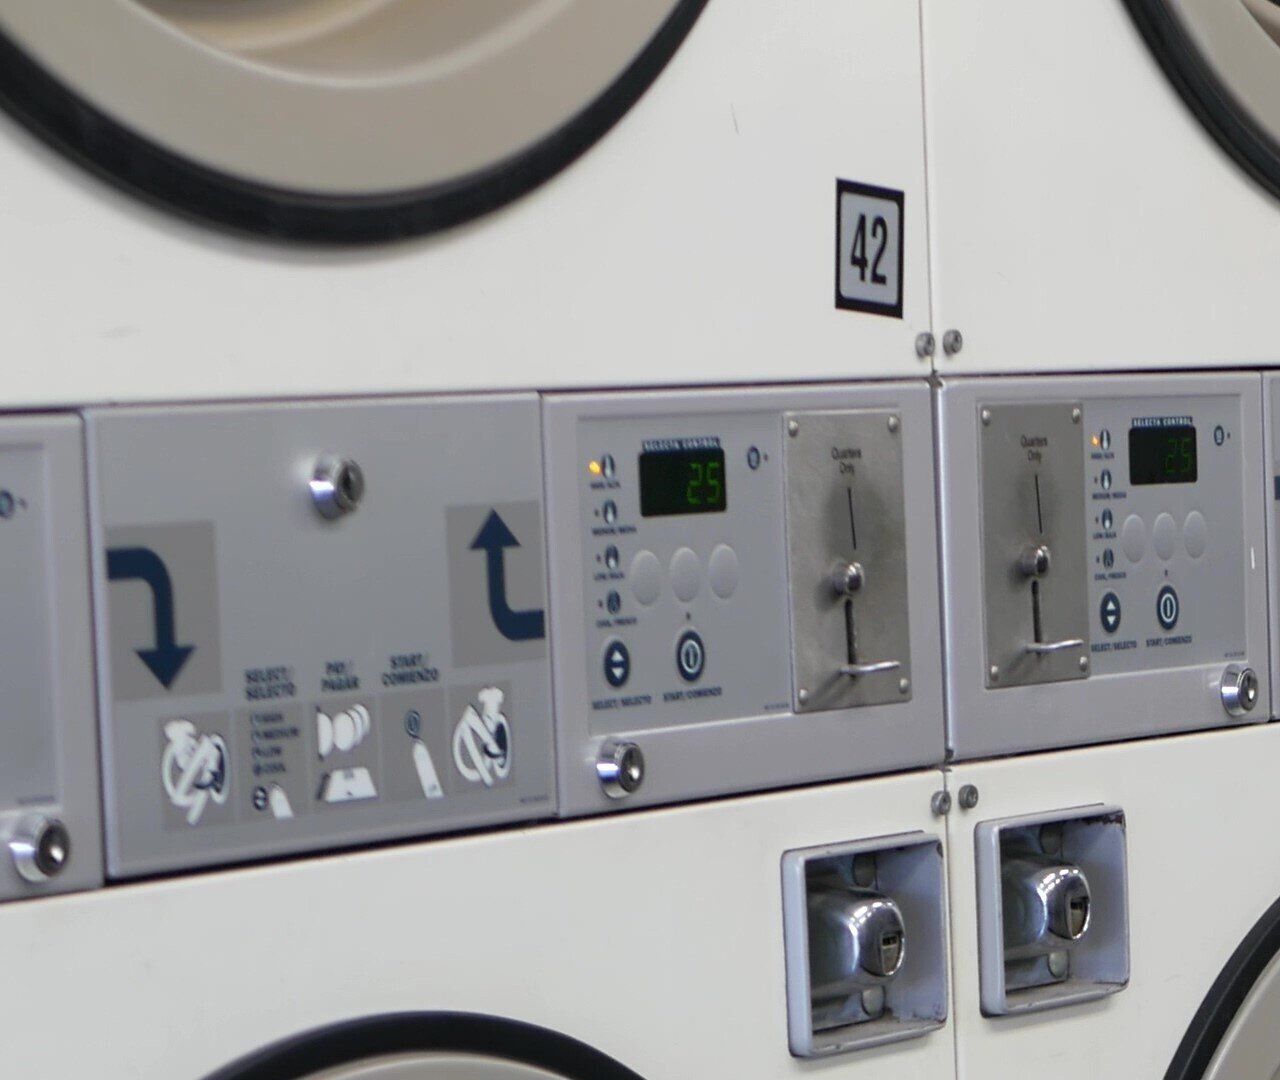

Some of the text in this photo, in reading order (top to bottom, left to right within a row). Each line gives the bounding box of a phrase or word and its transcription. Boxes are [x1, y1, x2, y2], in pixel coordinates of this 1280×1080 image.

[850, 213, 888, 286] 42
[1020, 434, 1048, 448] Quarters
[831, 446, 862, 460] Quarters
[1027, 449, 1042, 464] Only
[839, 461, 855, 476] Only
[686, 461, 721, 504] 25
